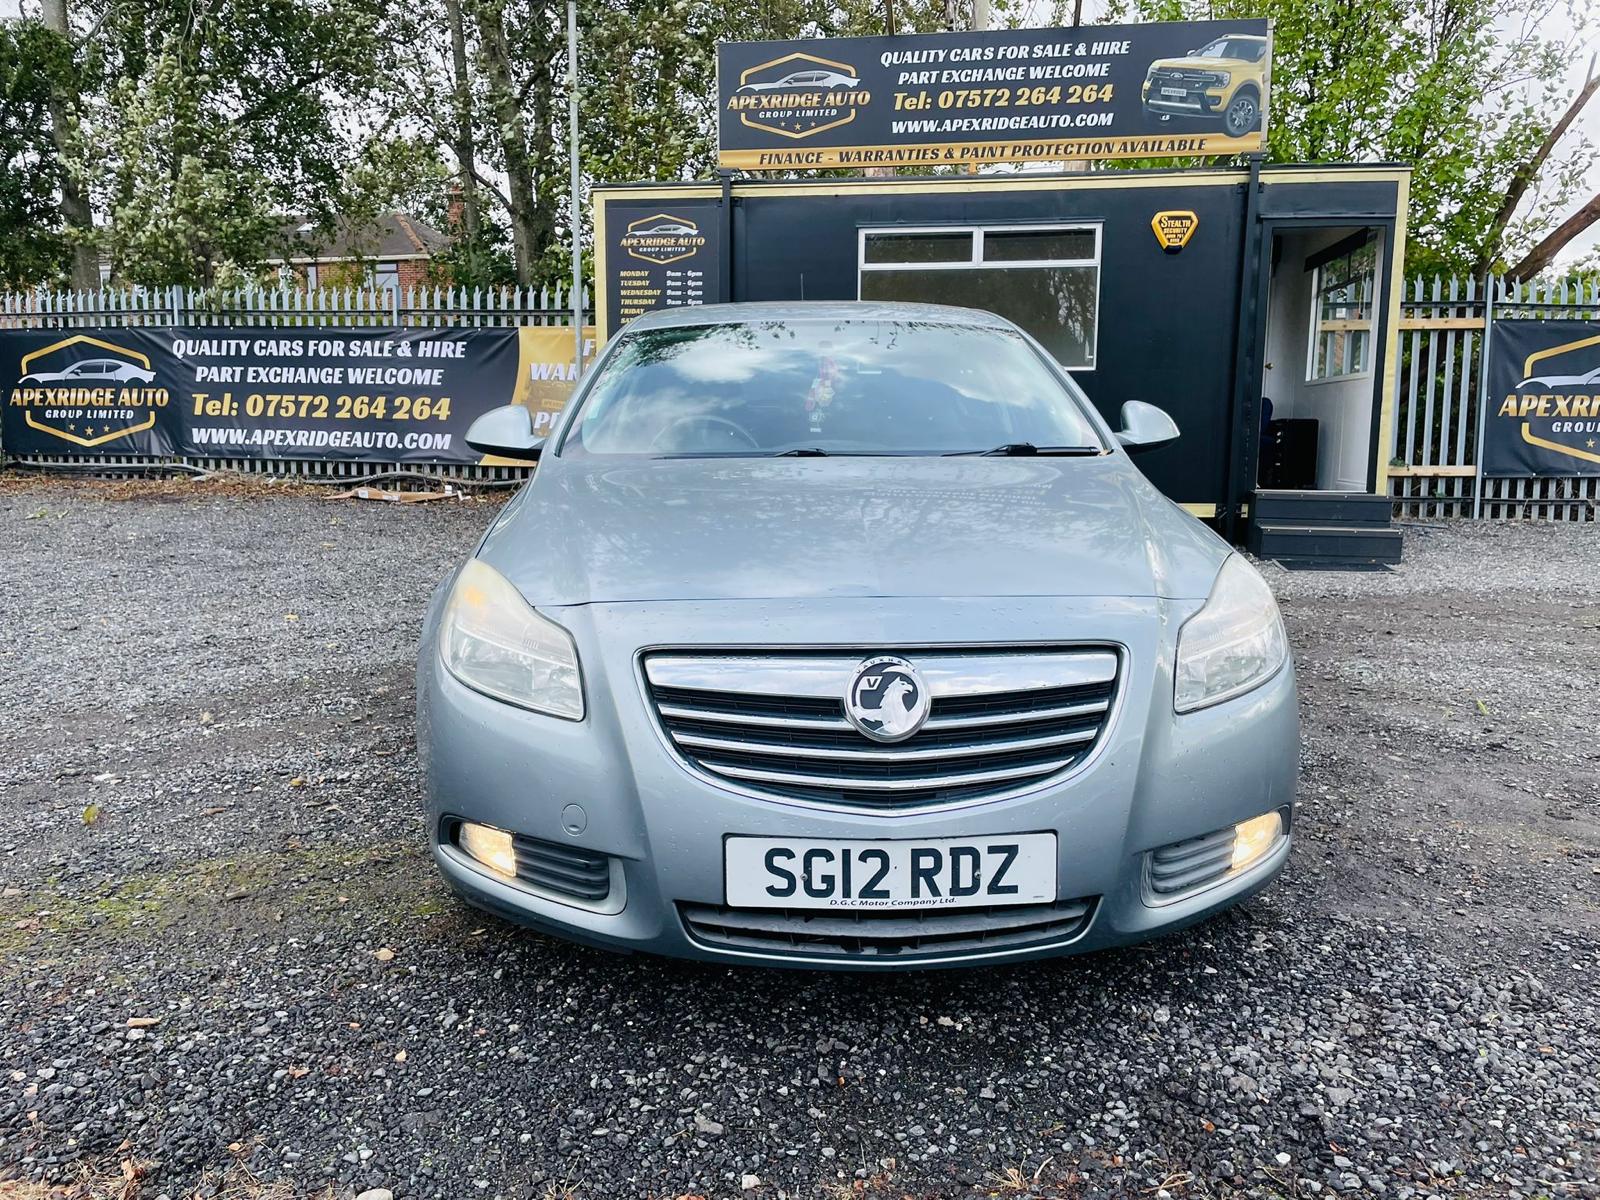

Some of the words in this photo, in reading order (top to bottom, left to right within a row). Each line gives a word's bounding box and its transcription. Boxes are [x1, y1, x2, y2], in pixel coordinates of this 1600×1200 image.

[880, 49, 948, 68] QUALITY
[949, 47, 994, 62] CARS
[997, 45, 1029, 60] FOR
[1032, 43, 1072, 58] SALE
[1075, 42, 1087, 56] &
[1091, 41, 1131, 55] HIRE
[898, 70, 940, 85] PART
[941, 66, 1026, 83] EXCHANGE
[1029, 63, 1111, 79] WELCOME
[727, 91, 822, 110] APEXRIDGE
[824, 90, 871, 107] AUTO
[894, 91, 932, 110] Tel:
[938, 88, 1010, 109] 07572
[1015, 86, 1061, 106] 264
[1066, 83, 1114, 104] 264
[759, 111, 792, 119] GROUP
[796, 108, 838, 118] LIMITED
[892, 112, 1114, 134] WWW.APEXRIDGEAUTO.COM
[759, 152, 824, 165] FINANCE
[839, 148, 940, 163] WARRANTIES
[944, 147, 955, 160] &
[960, 145, 1008, 159] PAINT
[1011, 142, 1115, 157] PROTECTION
[1118, 138, 1208, 154] AVAILABLE
[1161, 216, 1191, 227] STEALTH
[620, 238, 676, 246] APEXRIDGE
[677, 236, 705, 246] AUTO
[172, 339, 251, 359] QUALITY
[253, 340, 304, 357] CARS
[308, 340, 345, 357] FOR
[348, 340, 394, 357] SALE
[397, 340, 412, 357] &
[417, 341, 468, 358] HIRE
[195, 366, 244, 383] PART
[247, 367, 344, 384] EXCHANGE
[347, 367, 445, 386] WELCOME
[9, 388, 116, 407] APEXRIDGE
[118, 388, 169, 407] AUTO
[192, 393, 239, 416] Tel:
[245, 394, 329, 418] 07572
[335, 395, 387, 419] 264
[392, 396, 451, 421] 264
[45, 409, 83, 419] GROUP
[86, 409, 134, 420] LIMITED
[191, 428, 452, 450] WWW.APEXRIDGEAUTO.COM
[866, 678, 878, 688] V
[764, 847, 891, 899] SG12
[911, 844, 1019, 898] RDZ
[891, 898, 937, 907] Company
